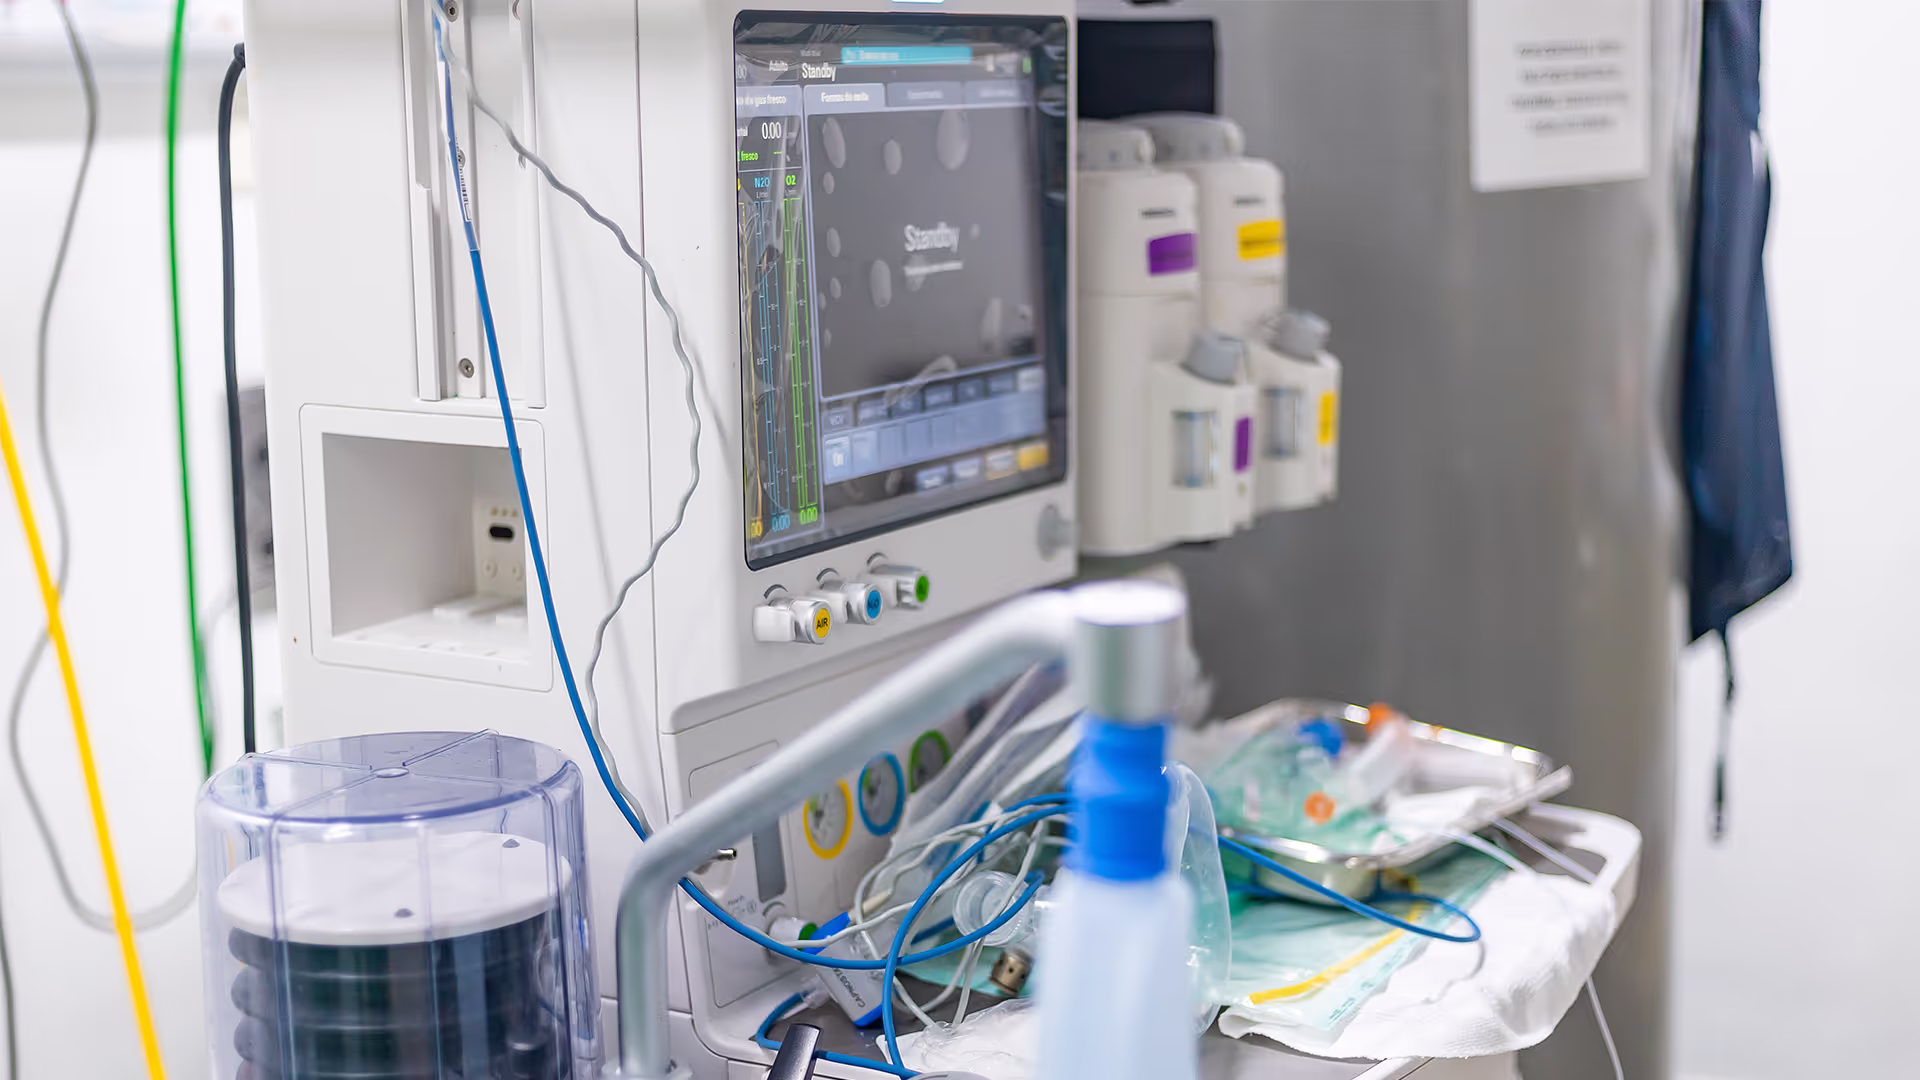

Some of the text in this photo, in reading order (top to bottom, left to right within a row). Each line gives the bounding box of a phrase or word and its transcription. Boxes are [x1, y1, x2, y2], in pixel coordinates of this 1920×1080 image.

[801, 62, 837, 82] Standby
[761, 121, 782, 140] 0.00
[754, 177, 771, 189] N2O
[785, 174, 797, 186] O2
[904, 221, 960, 255] Standby
[772, 514, 791, 533] 0.00
[800, 507, 818, 525] 0.00
[815, 616, 829, 630] AIR
